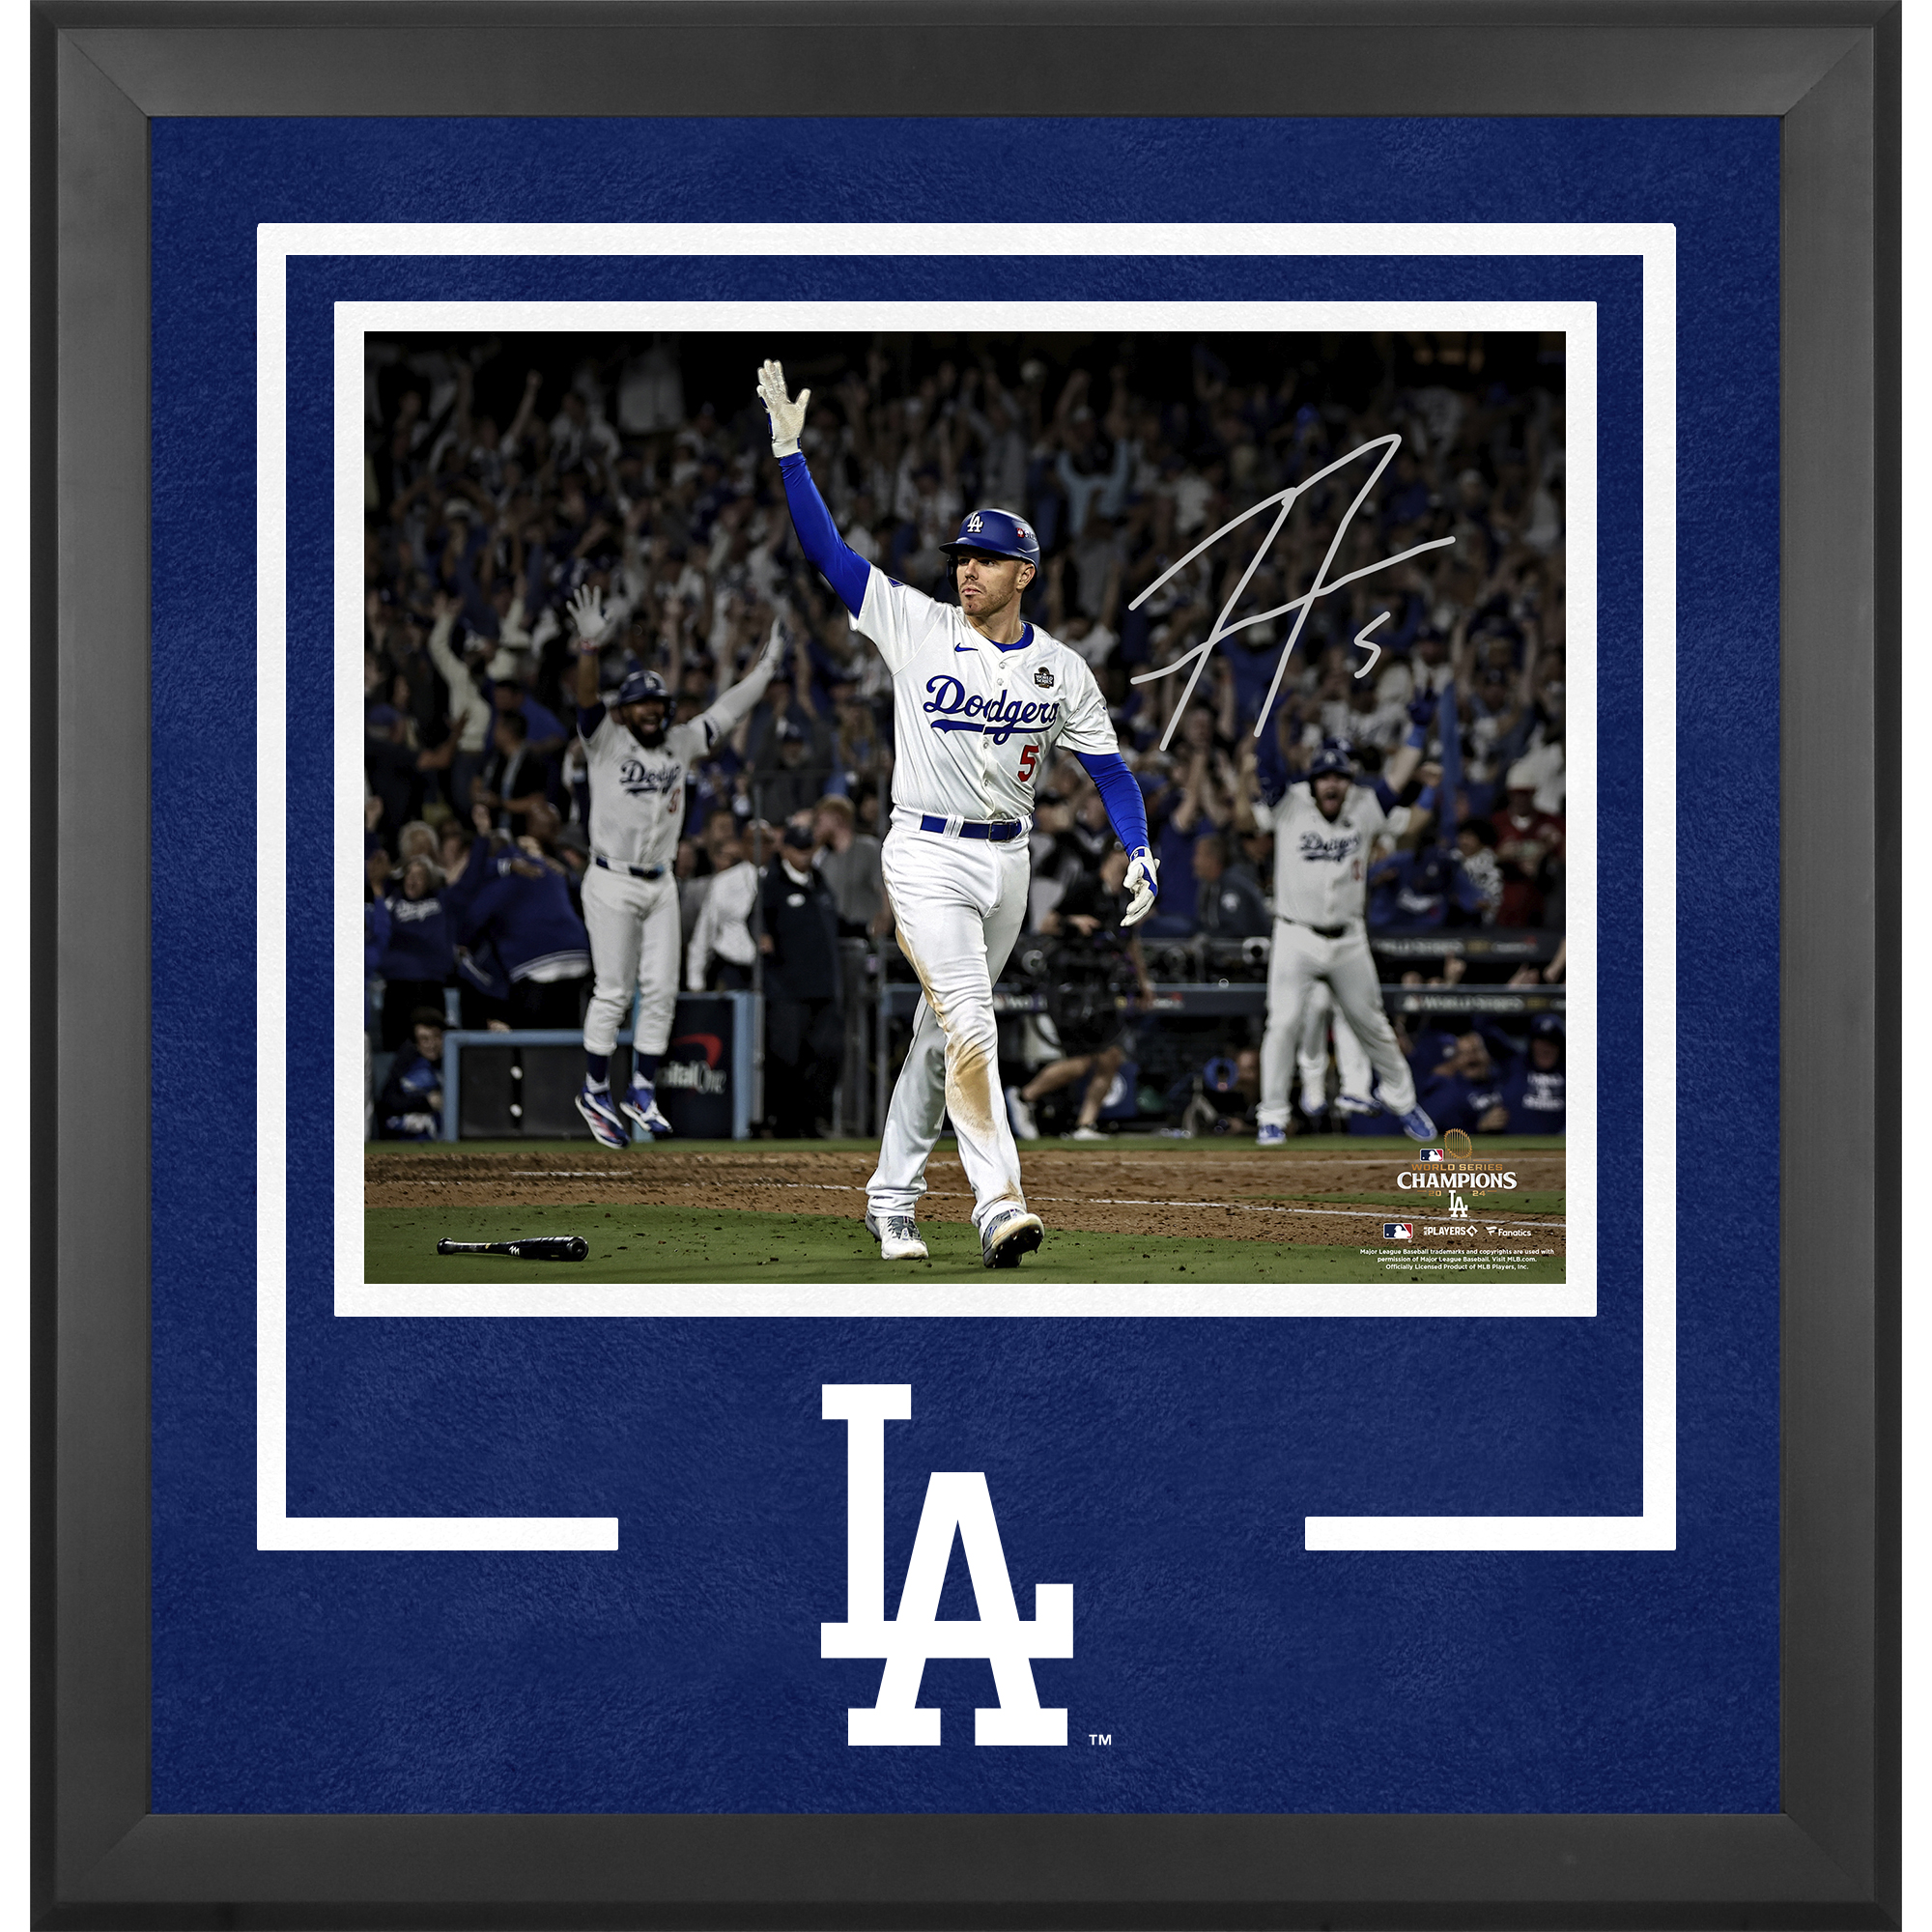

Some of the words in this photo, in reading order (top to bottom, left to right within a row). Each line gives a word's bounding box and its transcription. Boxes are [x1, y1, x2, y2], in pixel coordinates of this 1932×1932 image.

[967, 512, 983, 533] LA
[923, 674, 1060, 745] Dodgers
[1017, 745, 1039, 781] 5
[820, 1383, 1074, 1747] LA
[1089, 1734, 1112, 1746] TM
